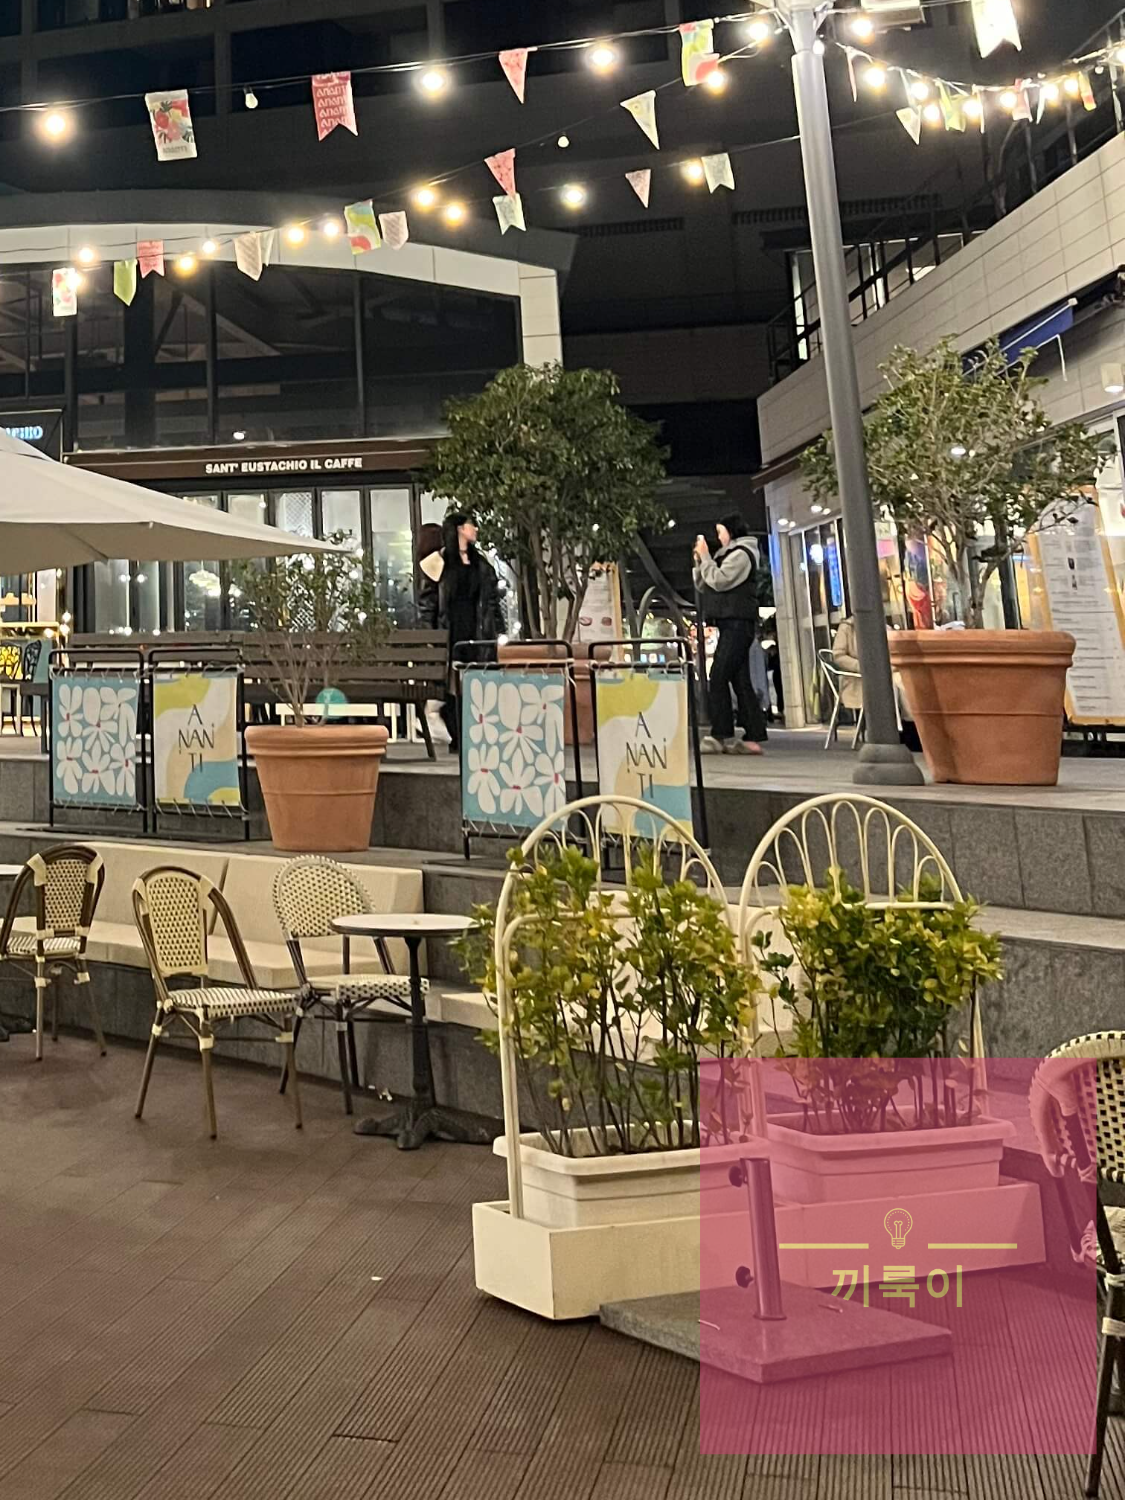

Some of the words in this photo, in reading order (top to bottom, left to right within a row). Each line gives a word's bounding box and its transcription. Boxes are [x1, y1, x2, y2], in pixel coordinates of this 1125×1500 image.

[241, 459, 308, 473] EUSTACHIO
[310, 459, 322, 470] IL
[188, 703, 203, 726] A
[635, 711, 652, 739] A
[188, 752, 203, 773] TI
[636, 772, 654, 799] TI
